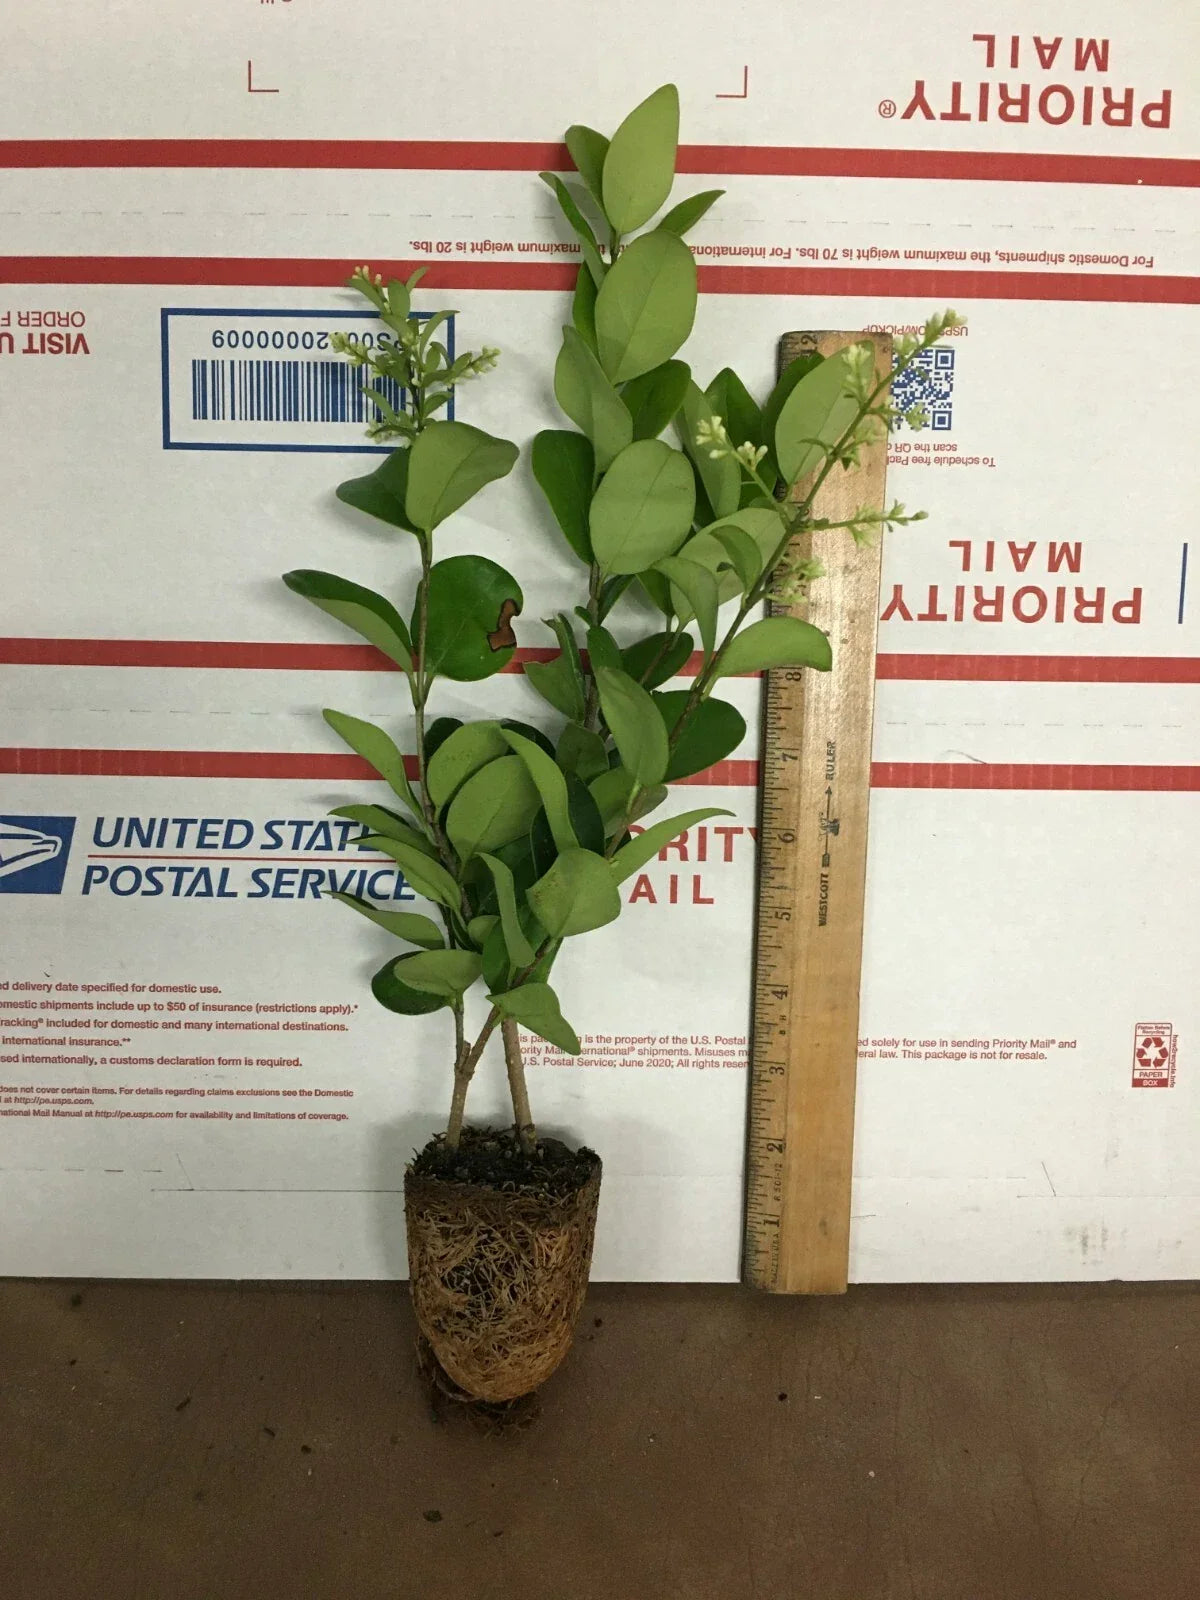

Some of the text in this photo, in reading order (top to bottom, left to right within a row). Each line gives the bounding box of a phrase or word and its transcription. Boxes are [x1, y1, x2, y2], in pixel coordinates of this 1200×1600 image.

[972, 33, 1110, 72] MAIL
[409, 240, 432, 252] lbs.
[434, 241, 452, 253] 20
[455, 242, 467, 253] is
[469, 239, 514, 254] weight
[518, 242, 581, 254] maximum
[688, 246, 766, 259] internationa
[770, 247, 791, 259] For
[796, 247, 819, 260] lbs.
[823, 248, 838, 260] 70
[842, 248, 853, 260] is
[856, 246, 900, 261] weight
[904, 250, 967, 262] maximum
[970, 251, 991, 263] the
[995, 250, 1065, 265] shipments,
[1069, 254, 1129, 267] Domestic
[1132, 256, 1154, 268] For
[17, 311, 86, 328] ORDER
[22, 332, 90, 355] VISIT
[894, 443, 911, 452] QR
[914, 443, 931, 453] the
[933, 443, 958, 452] scan
[911, 456, 932, 466] free
[934, 456, 980, 467] schedule
[982, 457, 996, 467] To
[948, 540, 1083, 573] MAIL
[879, 584, 1142, 624] PRIORITY
[785, 671, 802, 682] 8
[782, 752, 799, 762] 7
[92, 816, 380, 852] UNITED STAT
[778, 833, 795, 844] 6
[818, 741, 836, 927] WESTCOTT RULER
[82, 865, 416, 901] POSTAL SERVICE
[628, 874, 714, 905] AIL
[775, 911, 792, 921] 5
[12, 981, 53, 993] delivery
[55, 982, 79, 992] date
[80, 982, 129, 993] specified
[131, 982, 146, 993] for
[148, 983, 197, 993] domestic
[199, 985, 222, 994] use.
[771, 989, 788, 1000] 4
[39, 1000, 94, 1012] shipments
[96, 1001, 135, 1011] include
[137, 1003, 151, 1013] up
[153, 1002, 164, 1011] to
[166, 1001, 186, 1012] $50
[188, 1002, 200, 1012] of
[202, 1002, 253, 1012] insurance
[255, 1002, 317, 1014] (restrictions
[46, 1018, 91, 1028] included
[93, 1018, 109, 1029] for
[110, 1019, 158, 1029] domestic
[161, 1020, 182, 1029] and
[184, 1022, 213, 1032] many
[215, 1021, 280, 1031] international
[282, 1021, 349, 1032] destinations.
[2, 1036, 66, 1046] international
[585, 1035, 594, 1044] is
[596, 1035, 612, 1044] the
[614, 1036, 657, 1047] property
[659, 1035, 670, 1045] of
[672, 1035, 688, 1045] the
[690, 1036, 711, 1045] U.S.
[714, 1036, 746, 1045] Postal
[871, 1038, 900, 1050] solely
[902, 1038, 916, 1048] for
[919, 1039, 937, 1048] use
[939, 1038, 949, 1048] in
[951, 1038, 990, 1050] sending
[992, 1038, 1028, 1050] Priority
[1058, 1039, 1077, 1049] and
[637, 1047, 692, 1057] shipments.
[694, 1047, 736, 1057] Misuses
[879, 1050, 899, 1059] law.
[902, 1050, 922, 1059] This
[924, 1050, 967, 1061] package
[969, 1051, 978, 1060] is
[980, 1051, 997, 1060] not
[998, 1051, 1013, 1060] for
[1015, 1051, 1048, 1060] resale.
[22, 1054, 98, 1067] internationally,
[100, 1057, 107, 1065] a
[109, 1056, 154, 1066] customs
[156, 1056, 215, 1066] declaration
[217, 1057, 242, 1066] form
[244, 1057, 253, 1066] is
[255, 1057, 303, 1068] required.
[543, 1057, 574, 1067] Postal
[577, 1058, 616, 1068] Service;
[619, 1058, 644, 1067] June
[646, 1058, 674, 1069] 2020;
[676, 1058, 690, 1068] All
[692, 1058, 716, 1069] rights
[769, 1065, 785, 1075] 3
[20, 1086, 34, 1095] not
[35, 1087, 60, 1095] cover
[61, 1086, 90, 1095] certain
[91, 1086, 117, 1095] items.
[119, 1087, 133, 1095] For
[135, 1087, 164, 1096] details
[164, 1088, 205, 1098] regarding
[206, 1088, 234, 1097] claims
[236, 1088, 280, 1097] exclusions
[299, 1089, 313, 1097] the
[314, 1089, 354, 1097] Domestic
[4, 1096, 13, 1104] at
[14, 1096, 95, 1105] http://pe.usps.com.
[32, 1109, 51, 1117] Mail
[52, 1110, 83, 1118] Manual
[84, 1110, 93, 1118] at
[95, 1110, 174, 1120] http://pe.usps.com
[175, 1110, 187, 1118] for
[189, 1111, 234, 1121] availability
[235, 1111, 250, 1119] and
[253, 1111, 296, 1120] limitations
[297, 1112, 307, 1120] of
[308, 1113, 349, 1121] coverage.
[766, 1142, 784, 1154] 2
[763, 1219, 780, 1228] 1
